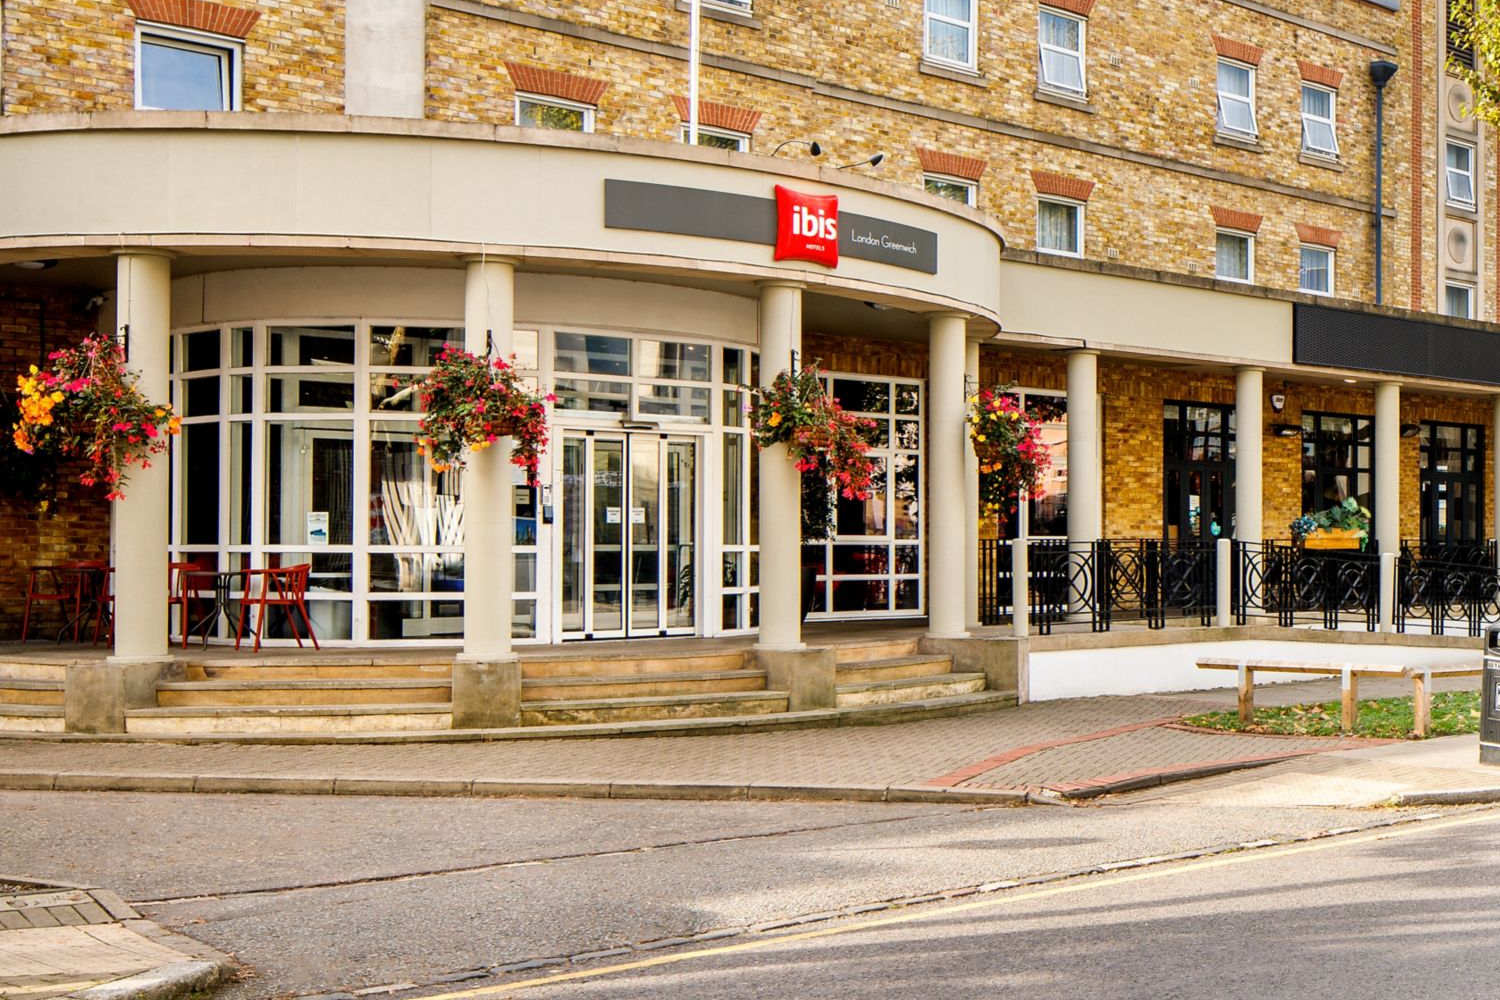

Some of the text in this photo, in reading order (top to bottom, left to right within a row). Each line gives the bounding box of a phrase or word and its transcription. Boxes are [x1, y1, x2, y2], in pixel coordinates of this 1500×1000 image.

[792, 205, 837, 240] ibis
[806, 244, 825, 252] HOTELS
[851, 229, 917, 254] London Greenwich
